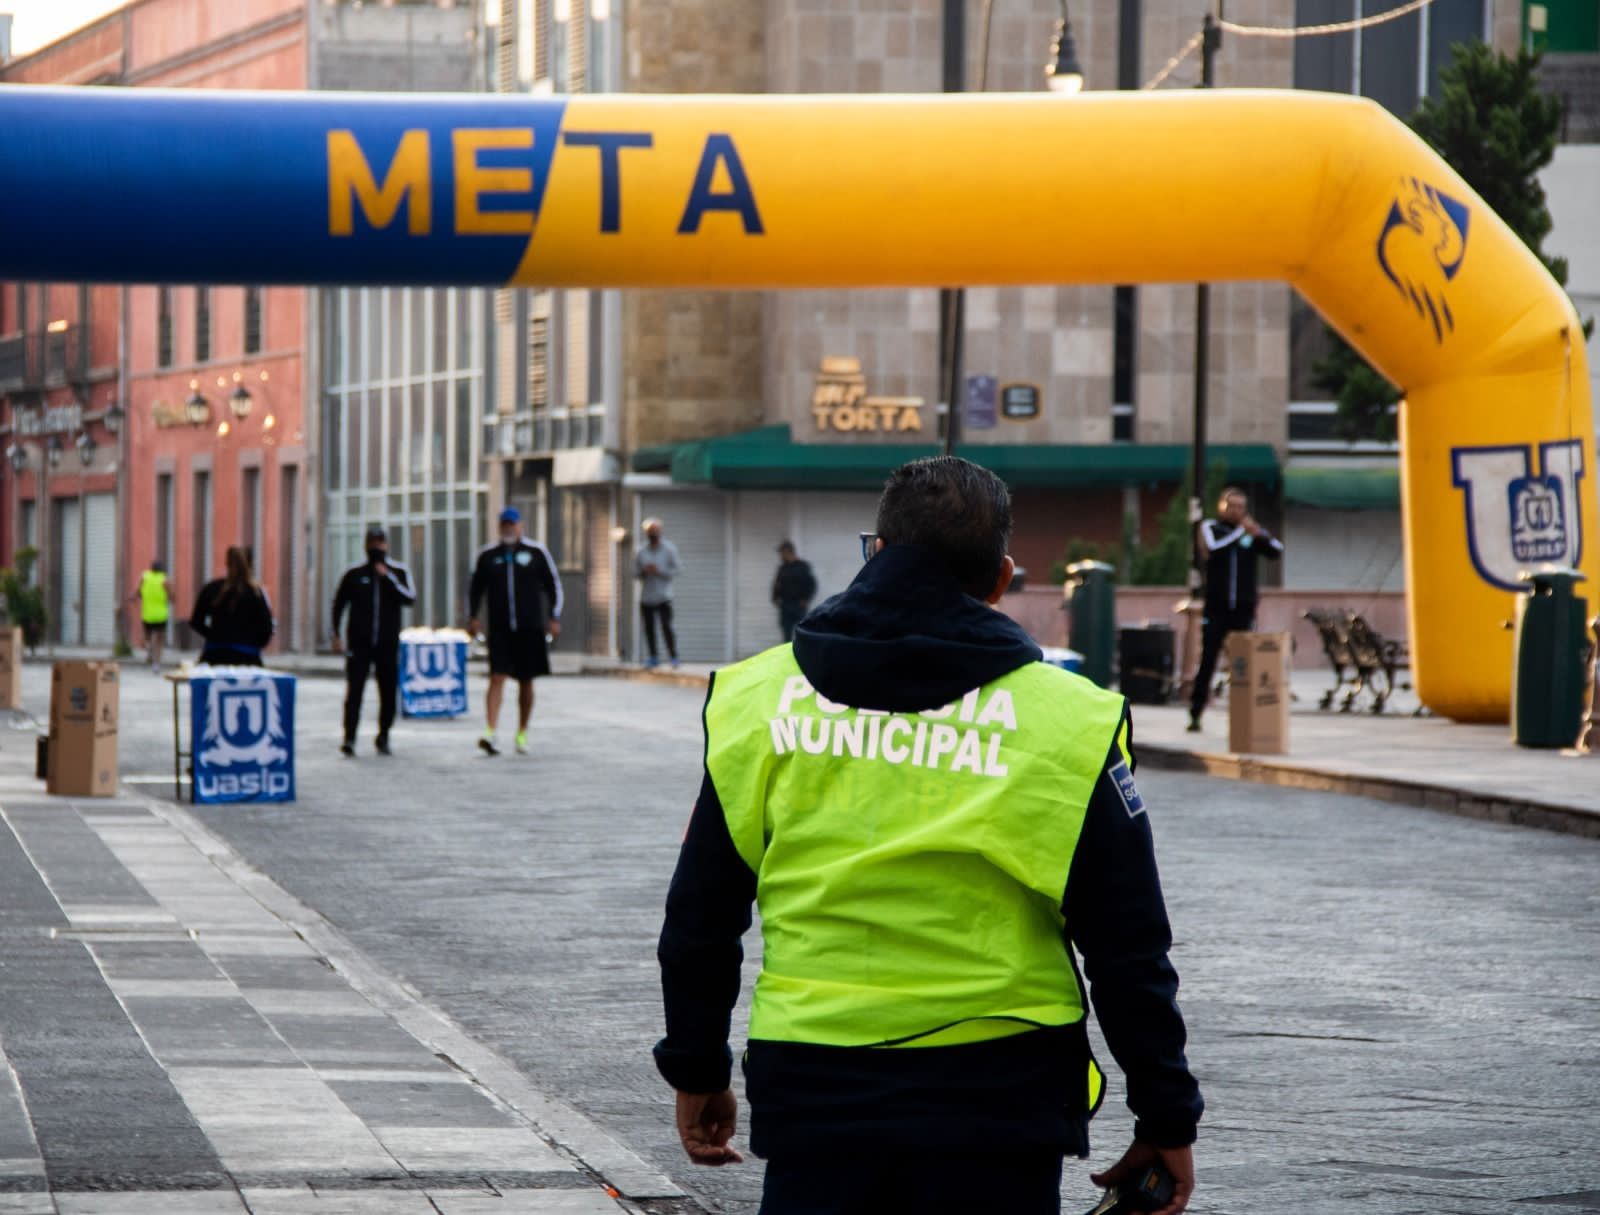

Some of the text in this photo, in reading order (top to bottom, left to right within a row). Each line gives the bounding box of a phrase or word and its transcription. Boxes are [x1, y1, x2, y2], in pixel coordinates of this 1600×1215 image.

[327, 127, 766, 236] META
[813, 406, 922, 432] TORTA
[198, 767, 290, 797] uaslp
